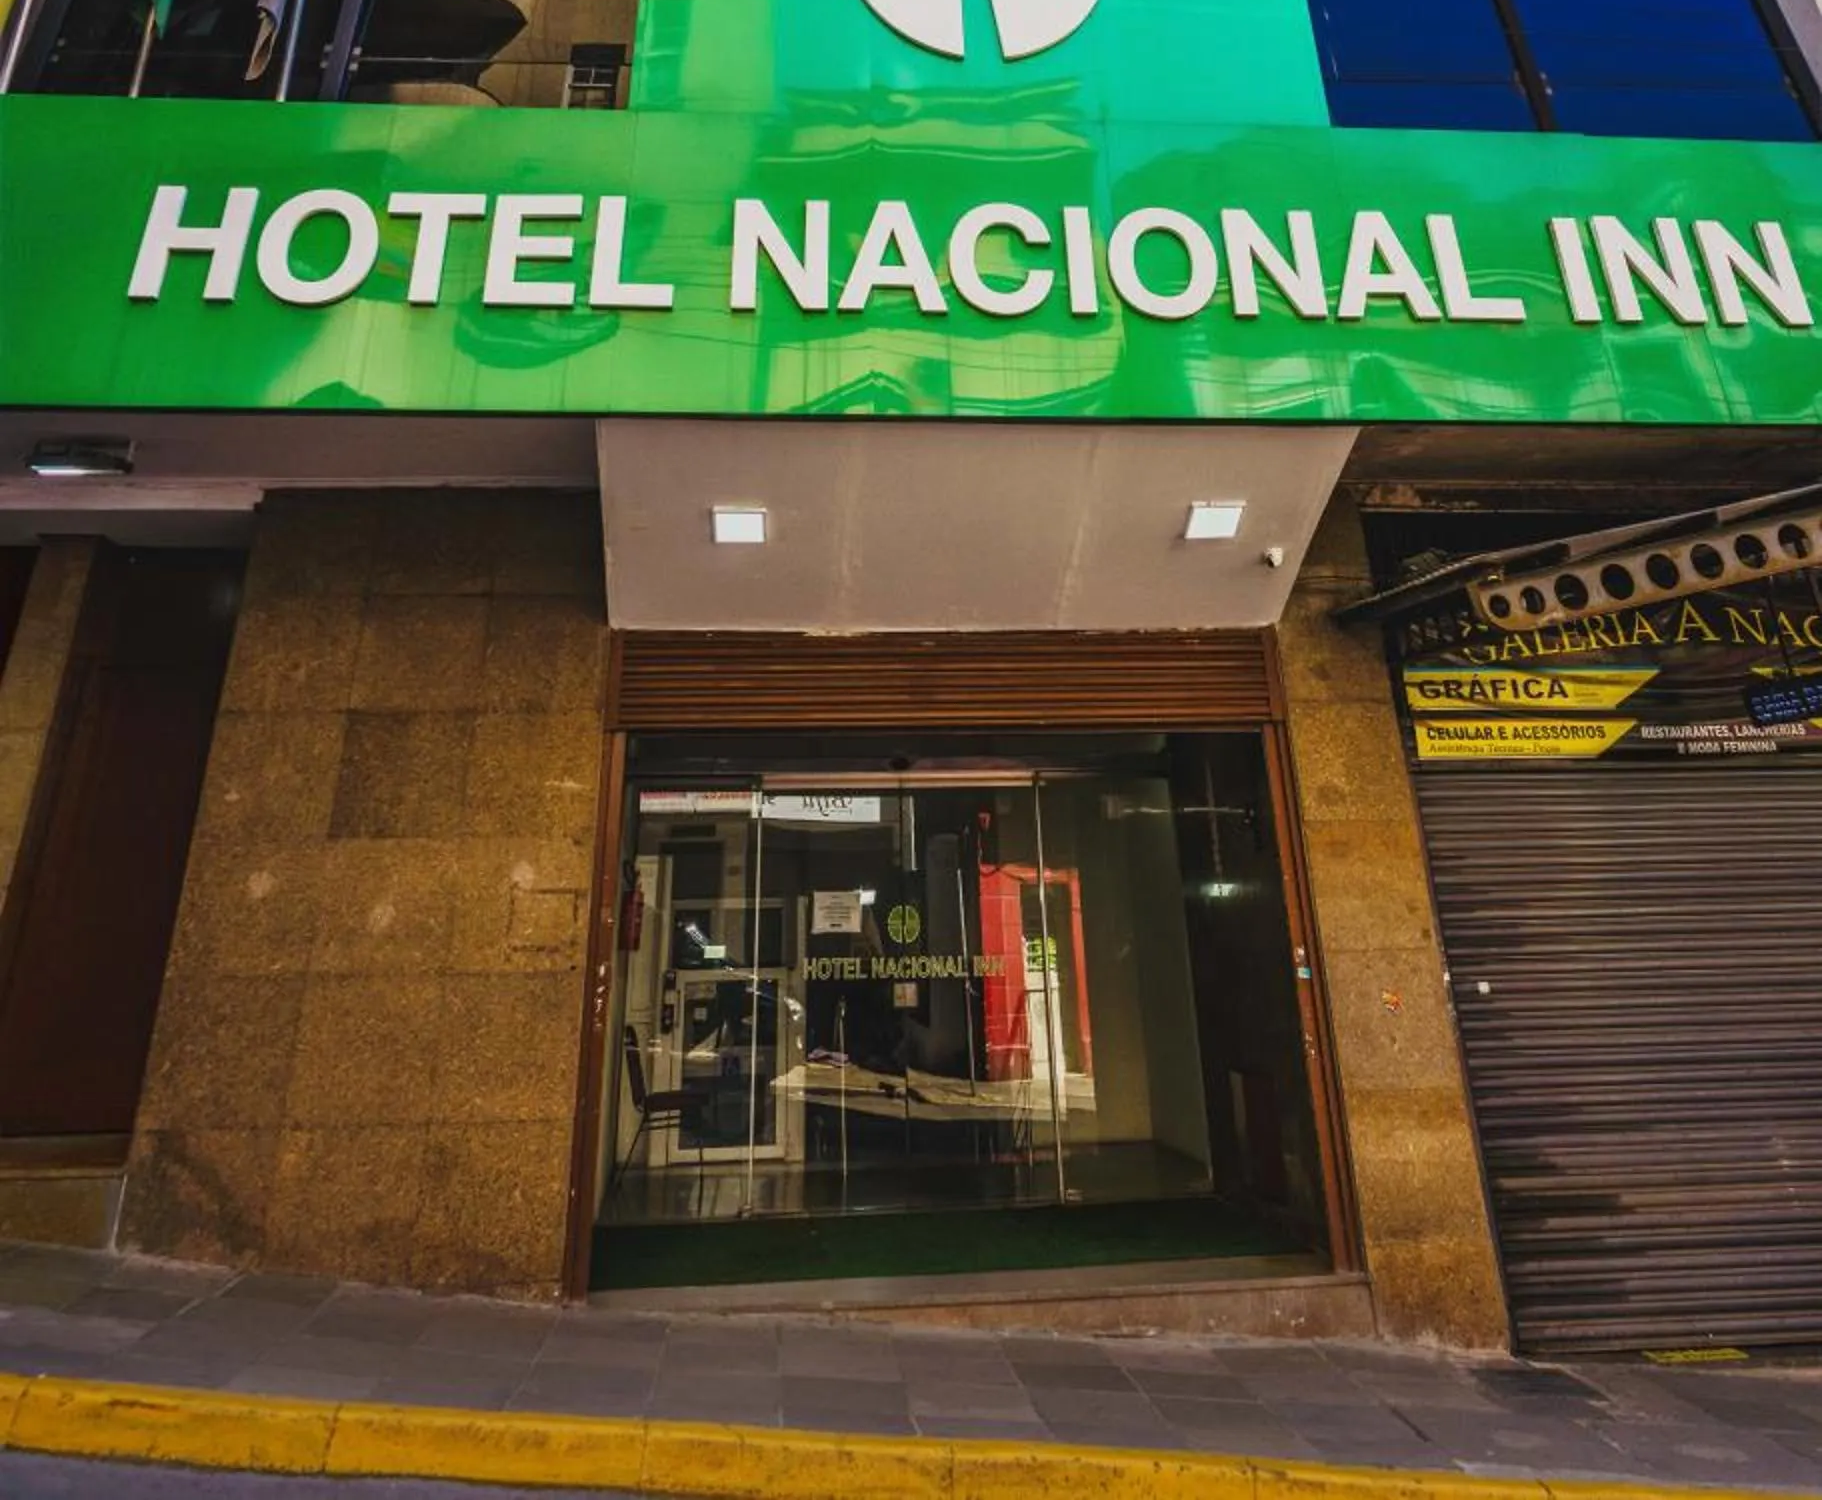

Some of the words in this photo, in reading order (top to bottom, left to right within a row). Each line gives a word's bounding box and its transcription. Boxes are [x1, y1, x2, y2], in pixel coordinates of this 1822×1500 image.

[127, 185, 673, 310] HOTEL
[730, 198, 1525, 323] NACIONAL
[1547, 215, 1814, 327] INN
[1674, 599, 1721, 642] A
[1418, 673, 1569, 700] GRÁFICA
[1427, 725, 1494, 741] CELULAR
[1499, 725, 1508, 740] E
[1512, 724, 1607, 740] ACESSÓRIOS
[803, 956, 869, 981] HOTEL
[872, 955, 969, 979] NACIONAL
[973, 954, 1006, 978] INN
